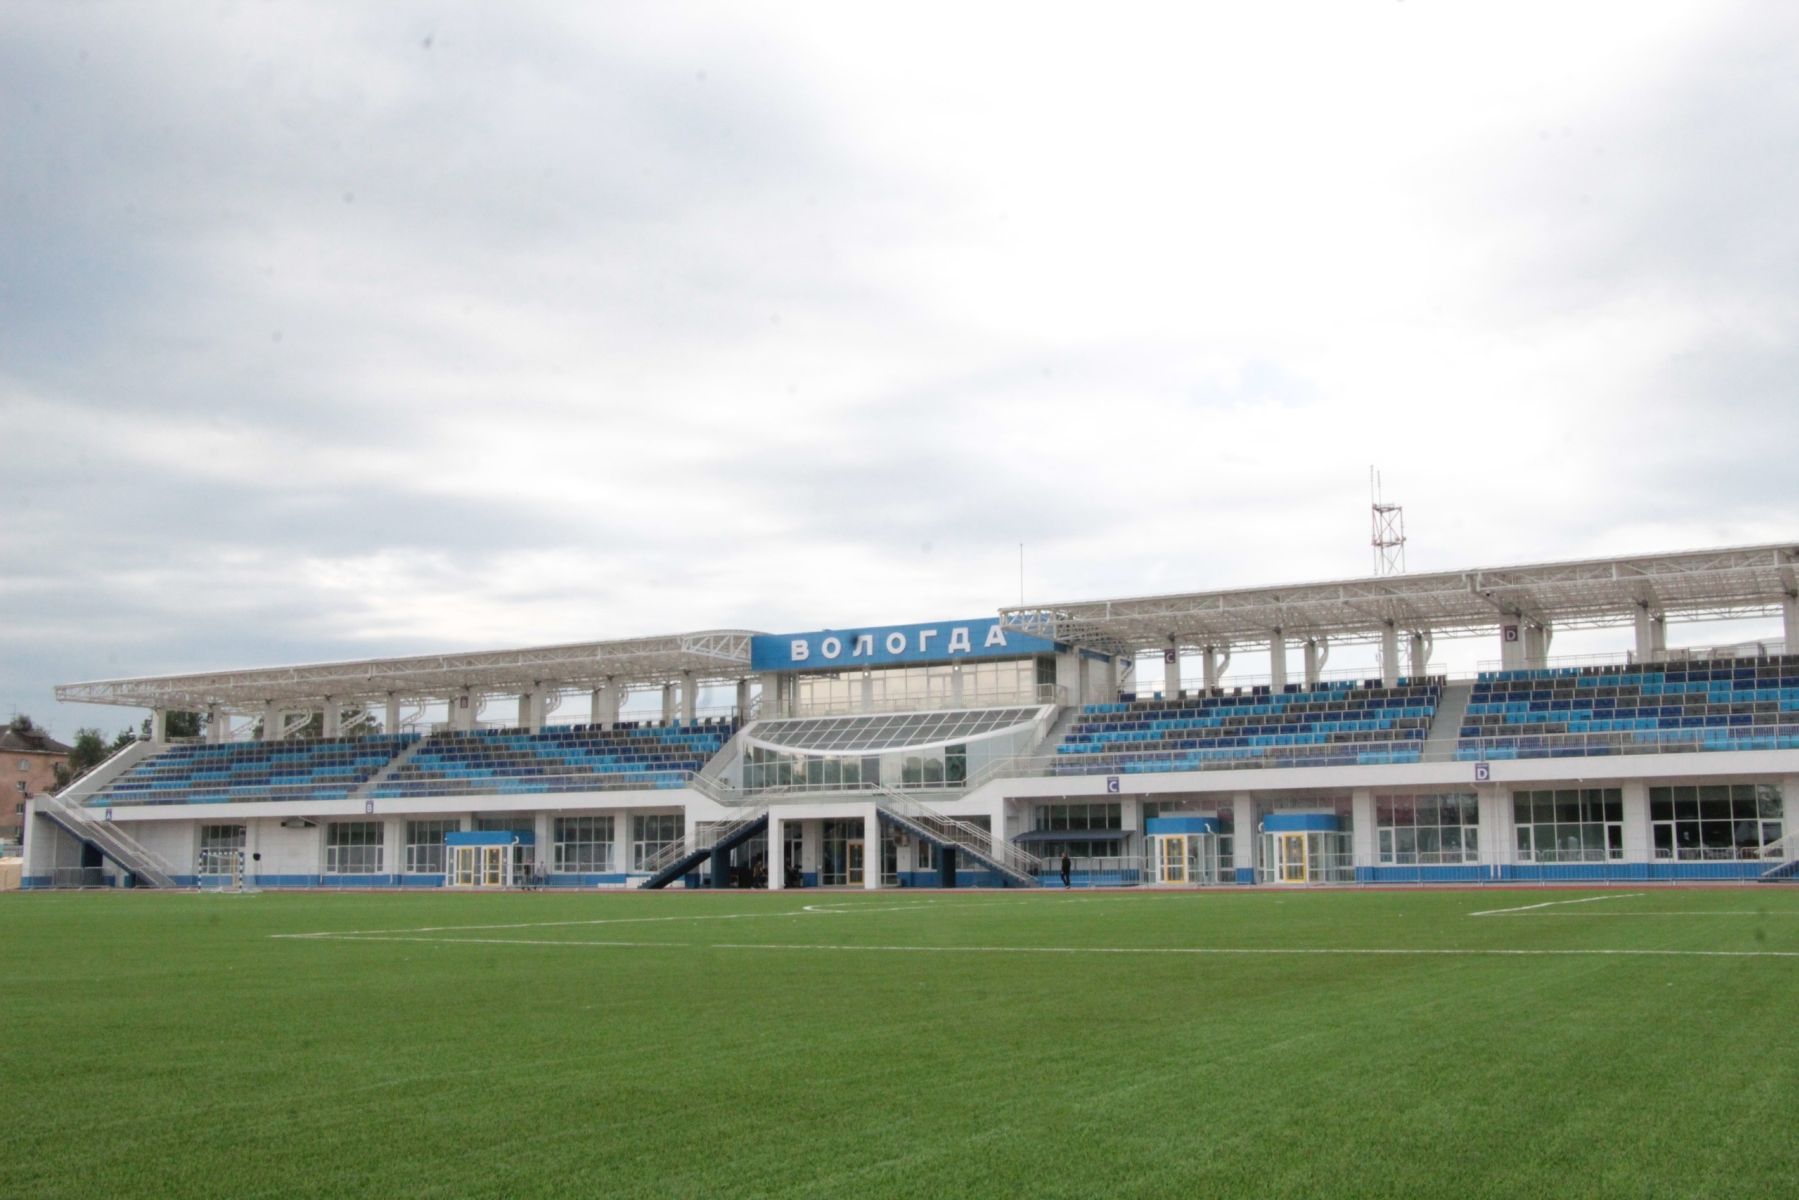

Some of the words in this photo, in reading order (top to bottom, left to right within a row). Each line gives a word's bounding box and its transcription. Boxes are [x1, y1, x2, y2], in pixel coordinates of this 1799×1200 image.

[1507, 630, 1516, 640] D
[791, 625, 1007, 661] ВОЛОГДА
[1166, 653, 1174, 663] C
[1477, 768, 1488, 780] D
[1109, 781, 1118, 792] C
